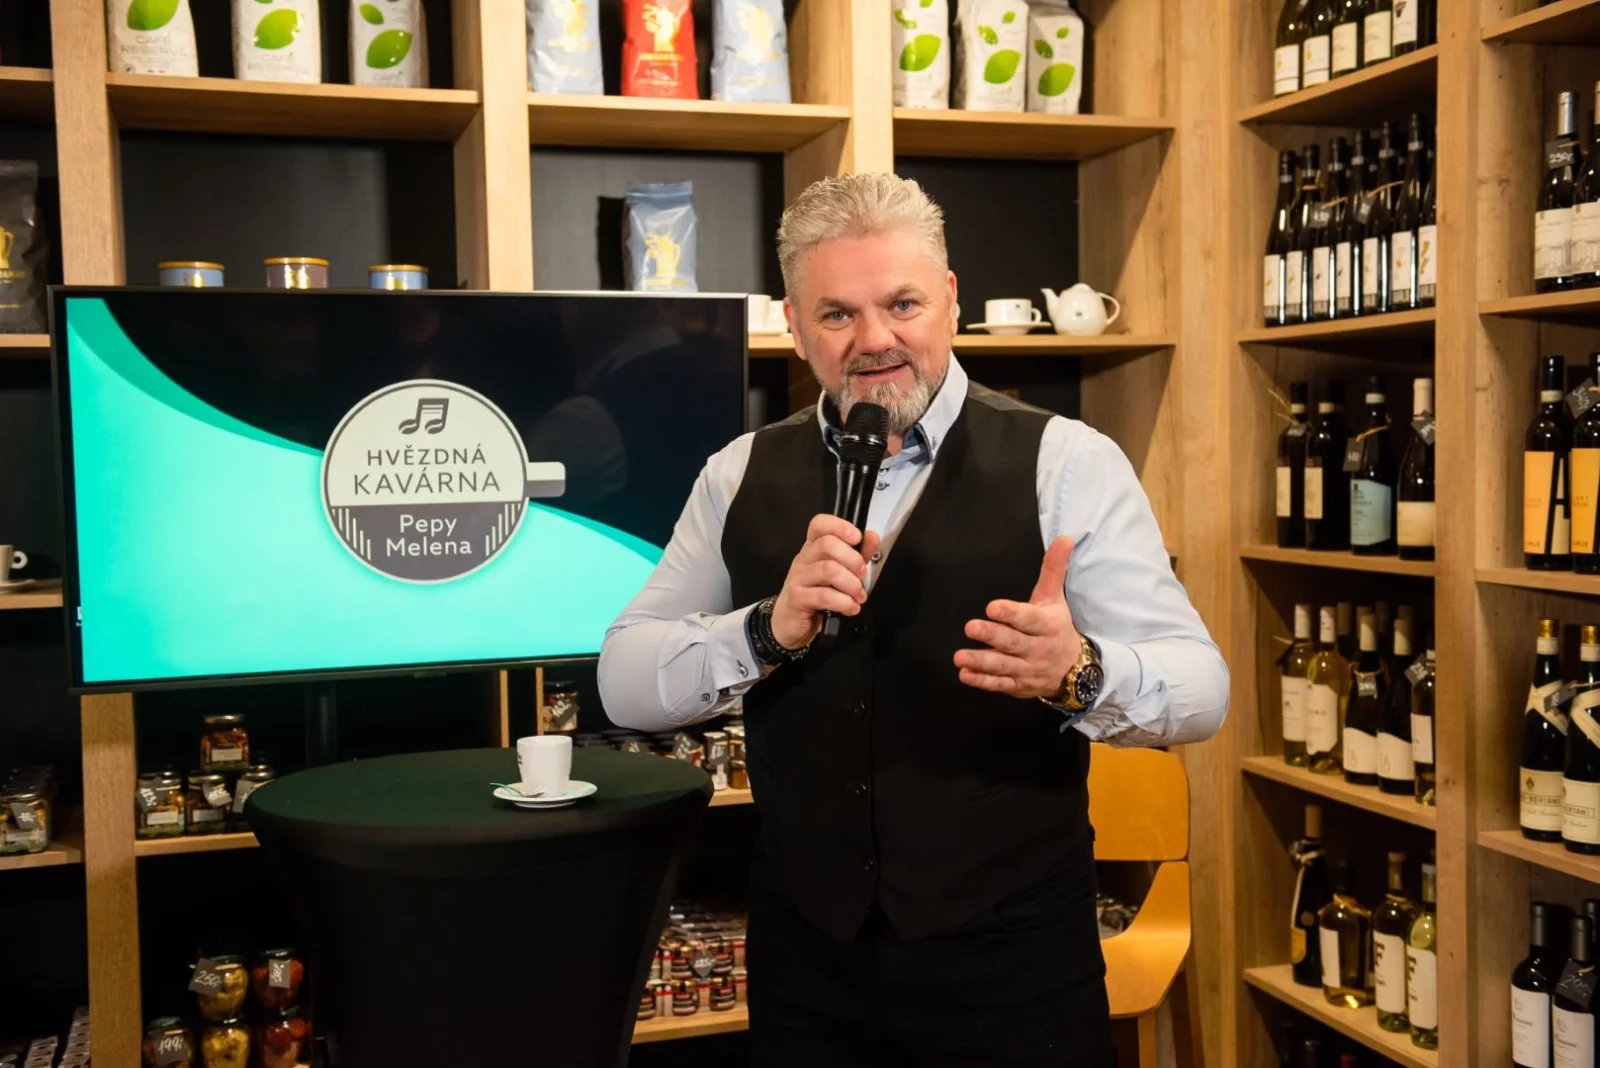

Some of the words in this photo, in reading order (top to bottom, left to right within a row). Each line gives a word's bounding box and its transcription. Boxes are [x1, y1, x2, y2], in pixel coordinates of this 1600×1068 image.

[367, 443, 487, 466] HVĚZDNÁ
[353, 466, 501, 496] KAVÁRNA
[399, 513, 458, 538] Pepy
[385, 535, 473, 558] Melena
